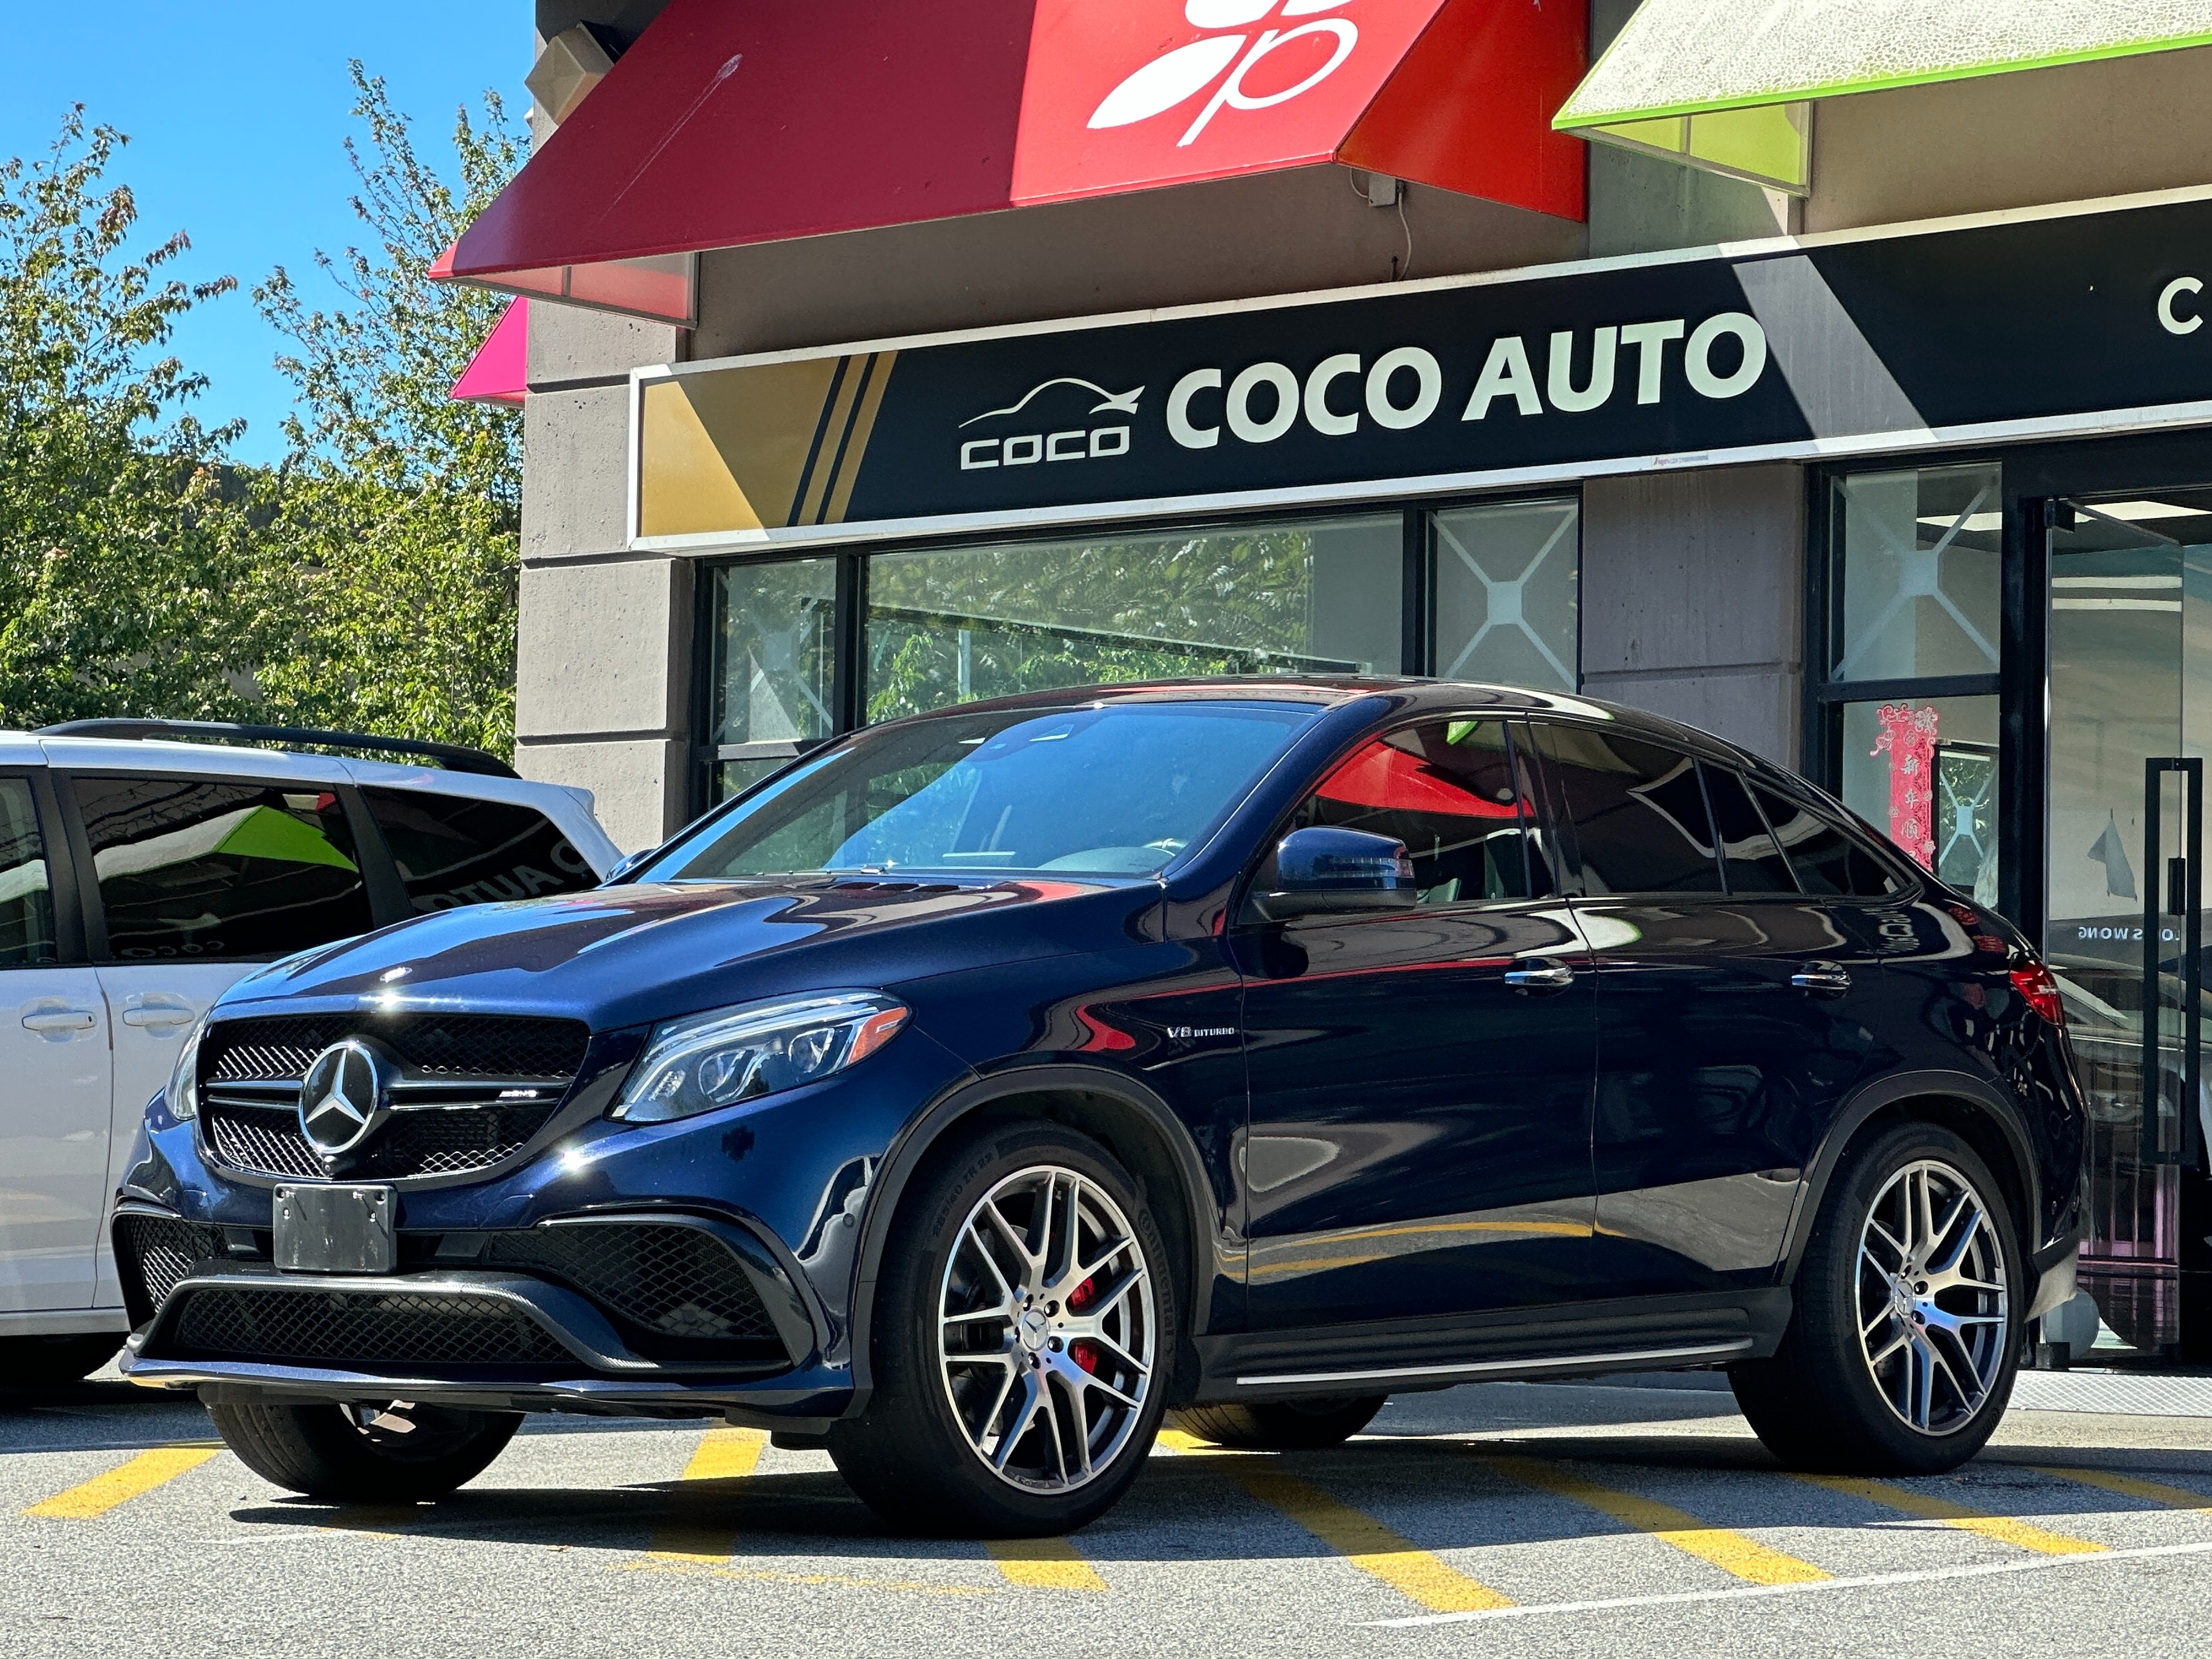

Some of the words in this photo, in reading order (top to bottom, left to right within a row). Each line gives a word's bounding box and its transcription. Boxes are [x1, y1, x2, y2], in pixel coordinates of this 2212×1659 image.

[2158, 276, 2203, 334] C
[1166, 346, 1442, 449] COCO
[1461, 312, 1766, 421] AUTO
[961, 426, 1130, 470] COCO
[1167, 1027, 1191, 1038] V8
[1194, 1027, 1235, 1037] BITURBO
